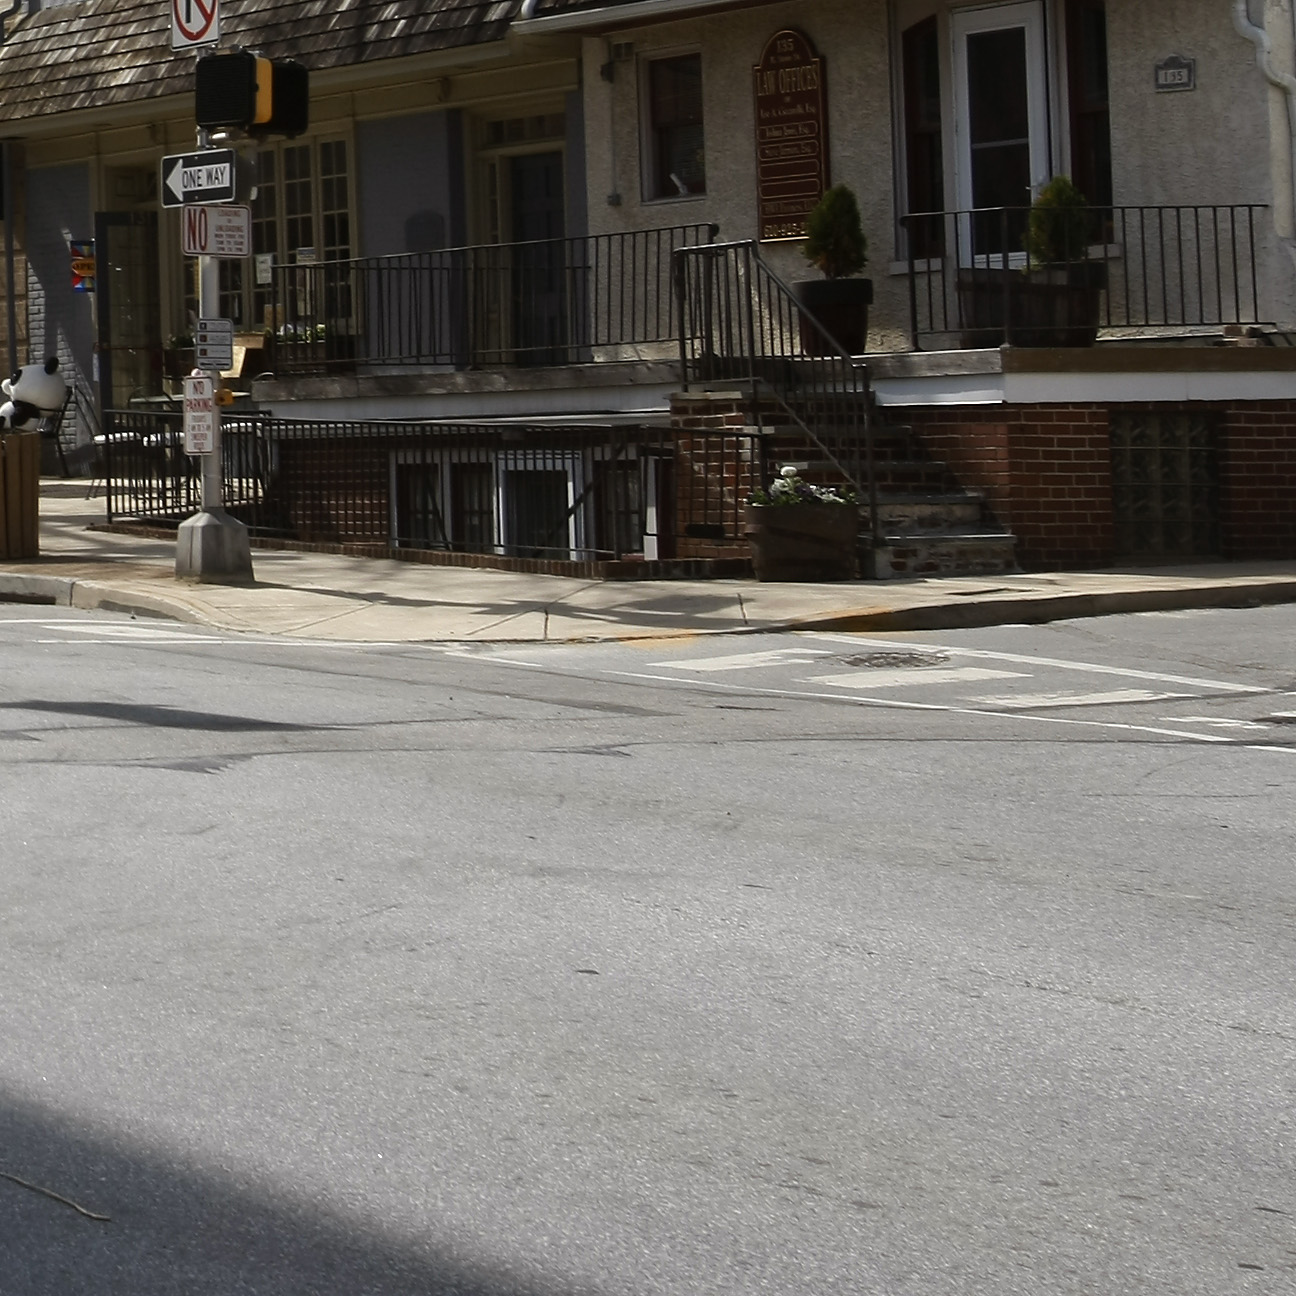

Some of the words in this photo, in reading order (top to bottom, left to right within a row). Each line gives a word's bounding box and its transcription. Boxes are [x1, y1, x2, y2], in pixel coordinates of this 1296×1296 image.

[756, 69, 777, 97] LAW
[778, 64, 818, 94] OFFICES
[181, 169, 203, 189] ONE
[205, 165, 226, 186] WAY
[188, 207, 208, 252] NO
[192, 380, 205, 395] NO
[186, 398, 213, 413] PARKING
